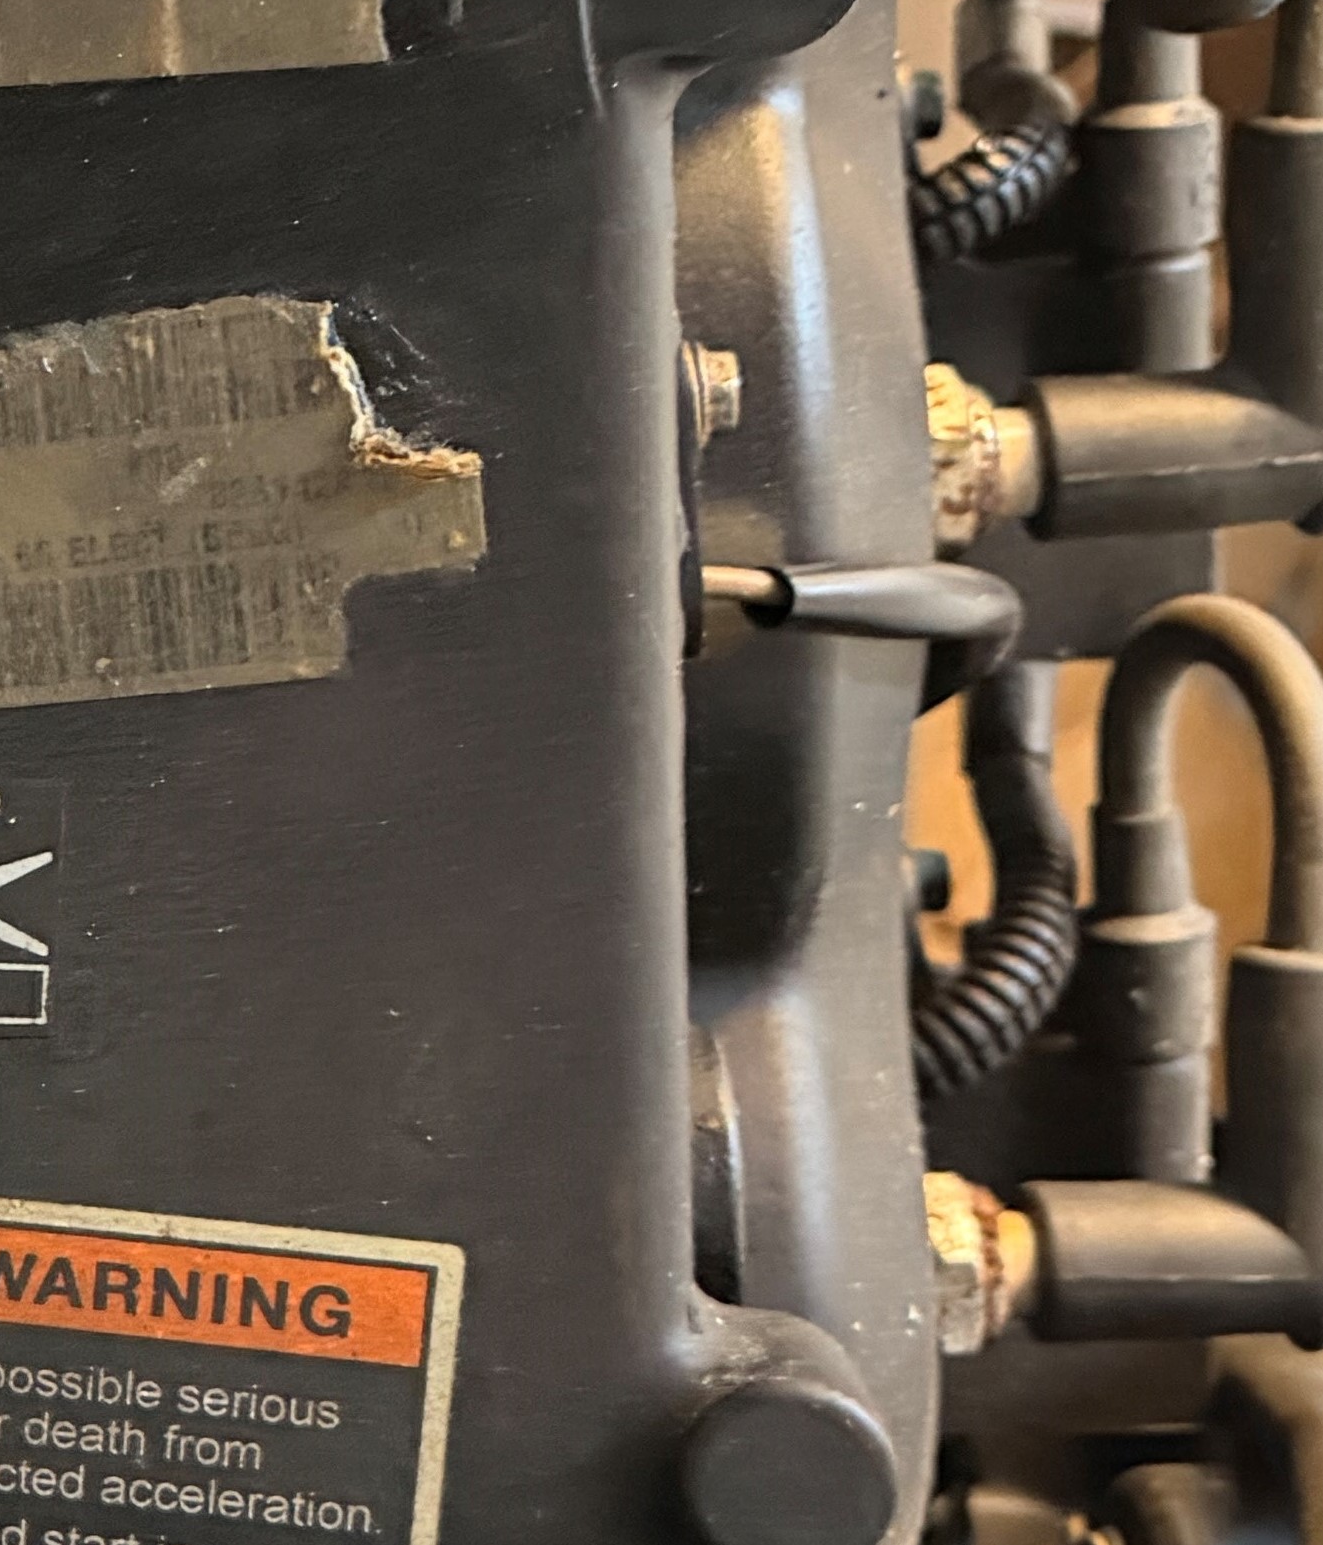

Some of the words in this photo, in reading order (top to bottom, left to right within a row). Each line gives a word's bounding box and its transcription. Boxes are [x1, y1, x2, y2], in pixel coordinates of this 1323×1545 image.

[177, 1384, 341, 1429] serious
[24, 1412, 146, 1457] death
[163, 1424, 262, 1470] from
[100, 1478, 383, 1534] acceleration.
